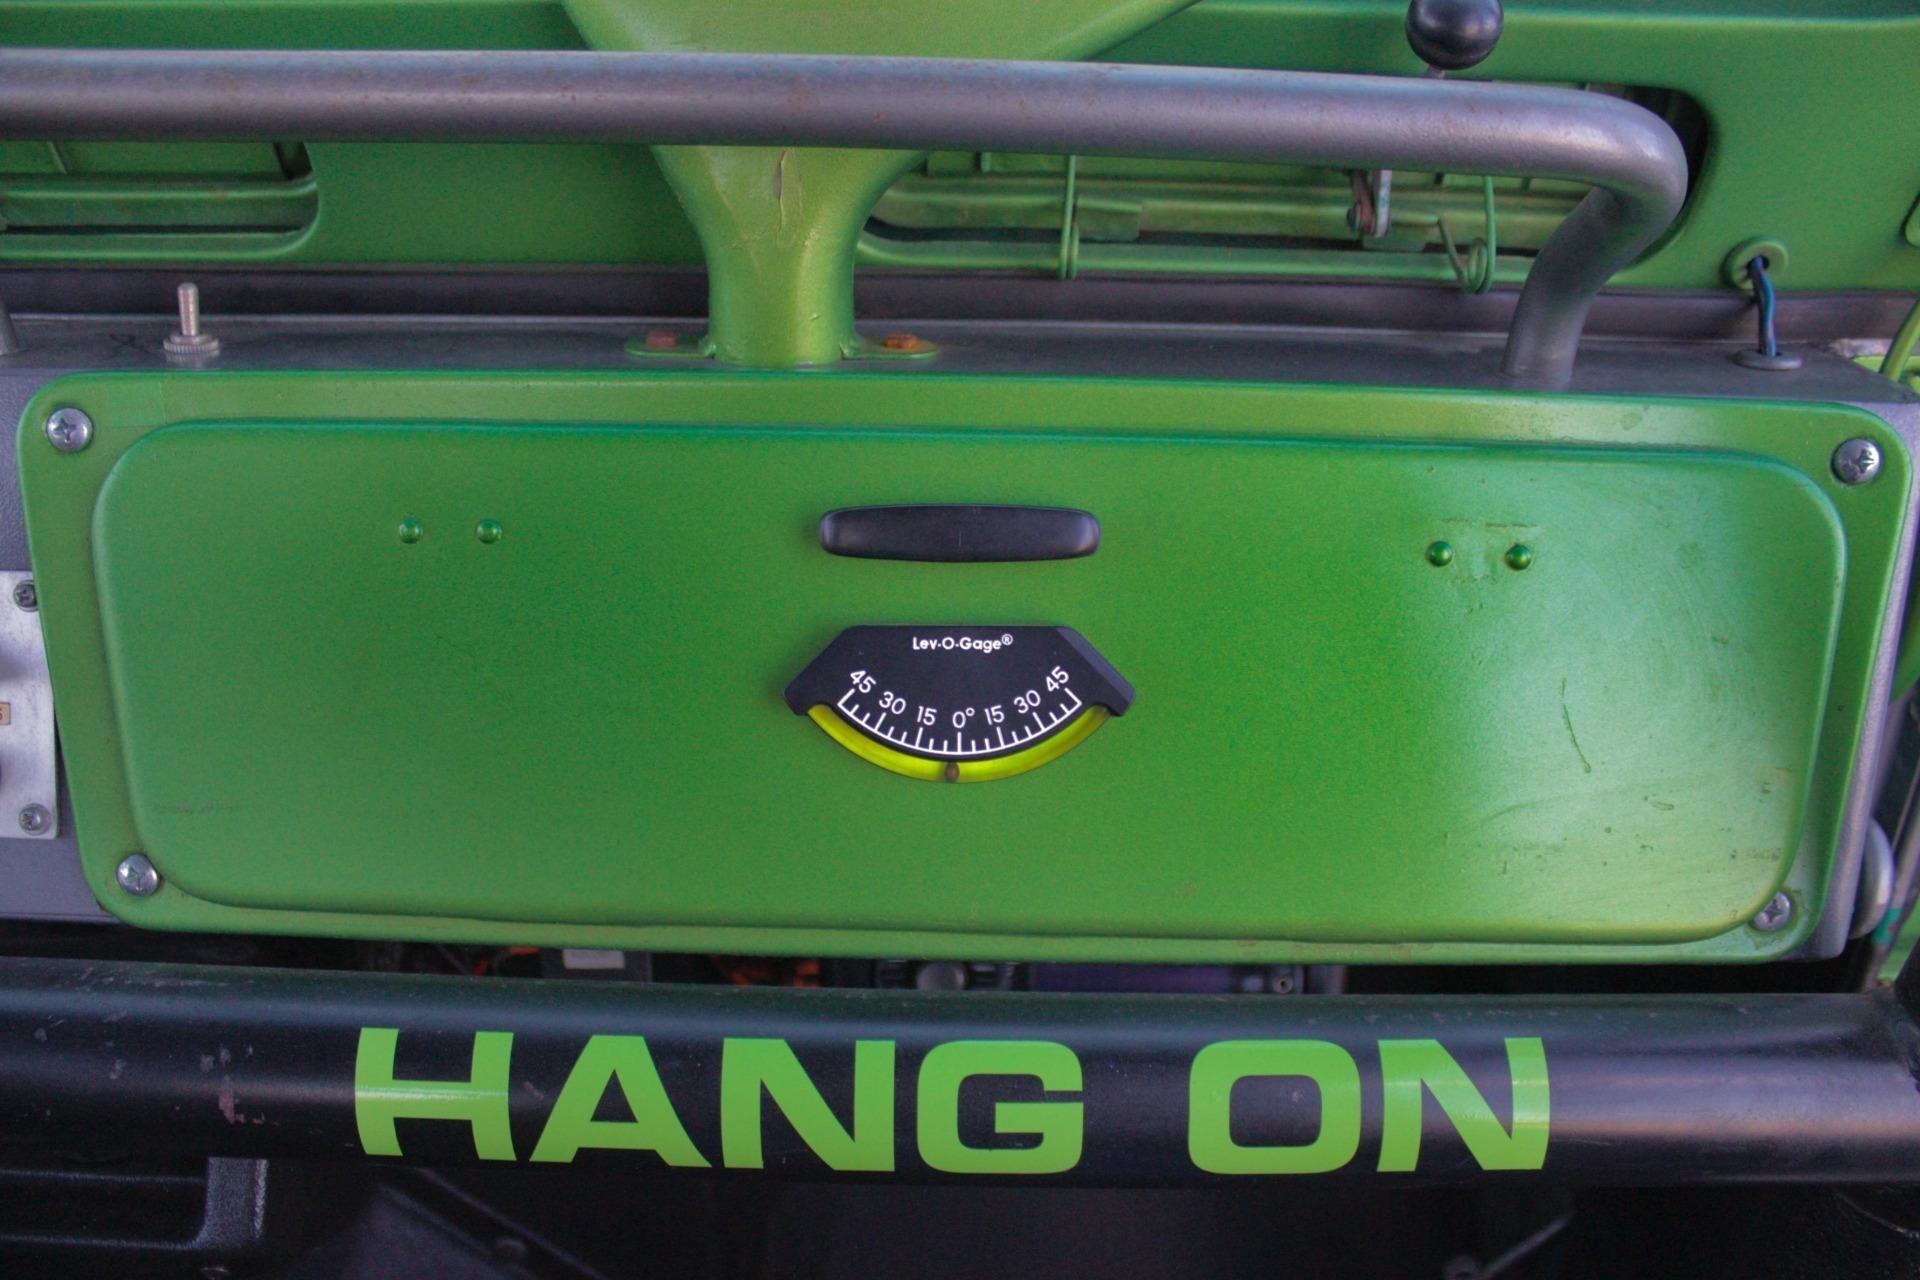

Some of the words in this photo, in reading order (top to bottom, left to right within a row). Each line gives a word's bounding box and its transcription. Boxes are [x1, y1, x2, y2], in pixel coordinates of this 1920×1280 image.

[849, 670, 877, 693] 45
[878, 690, 907, 715] 30
[916, 705, 938, 726] 15
[951, 707, 976, 729] 0°
[983, 704, 1005, 726] 15
[1013, 689, 1042, 714] 30
[1045, 665, 1070, 693] 45
[355, 1028, 1084, 1172] HANG
[1189, 1037, 1550, 1172] ON
